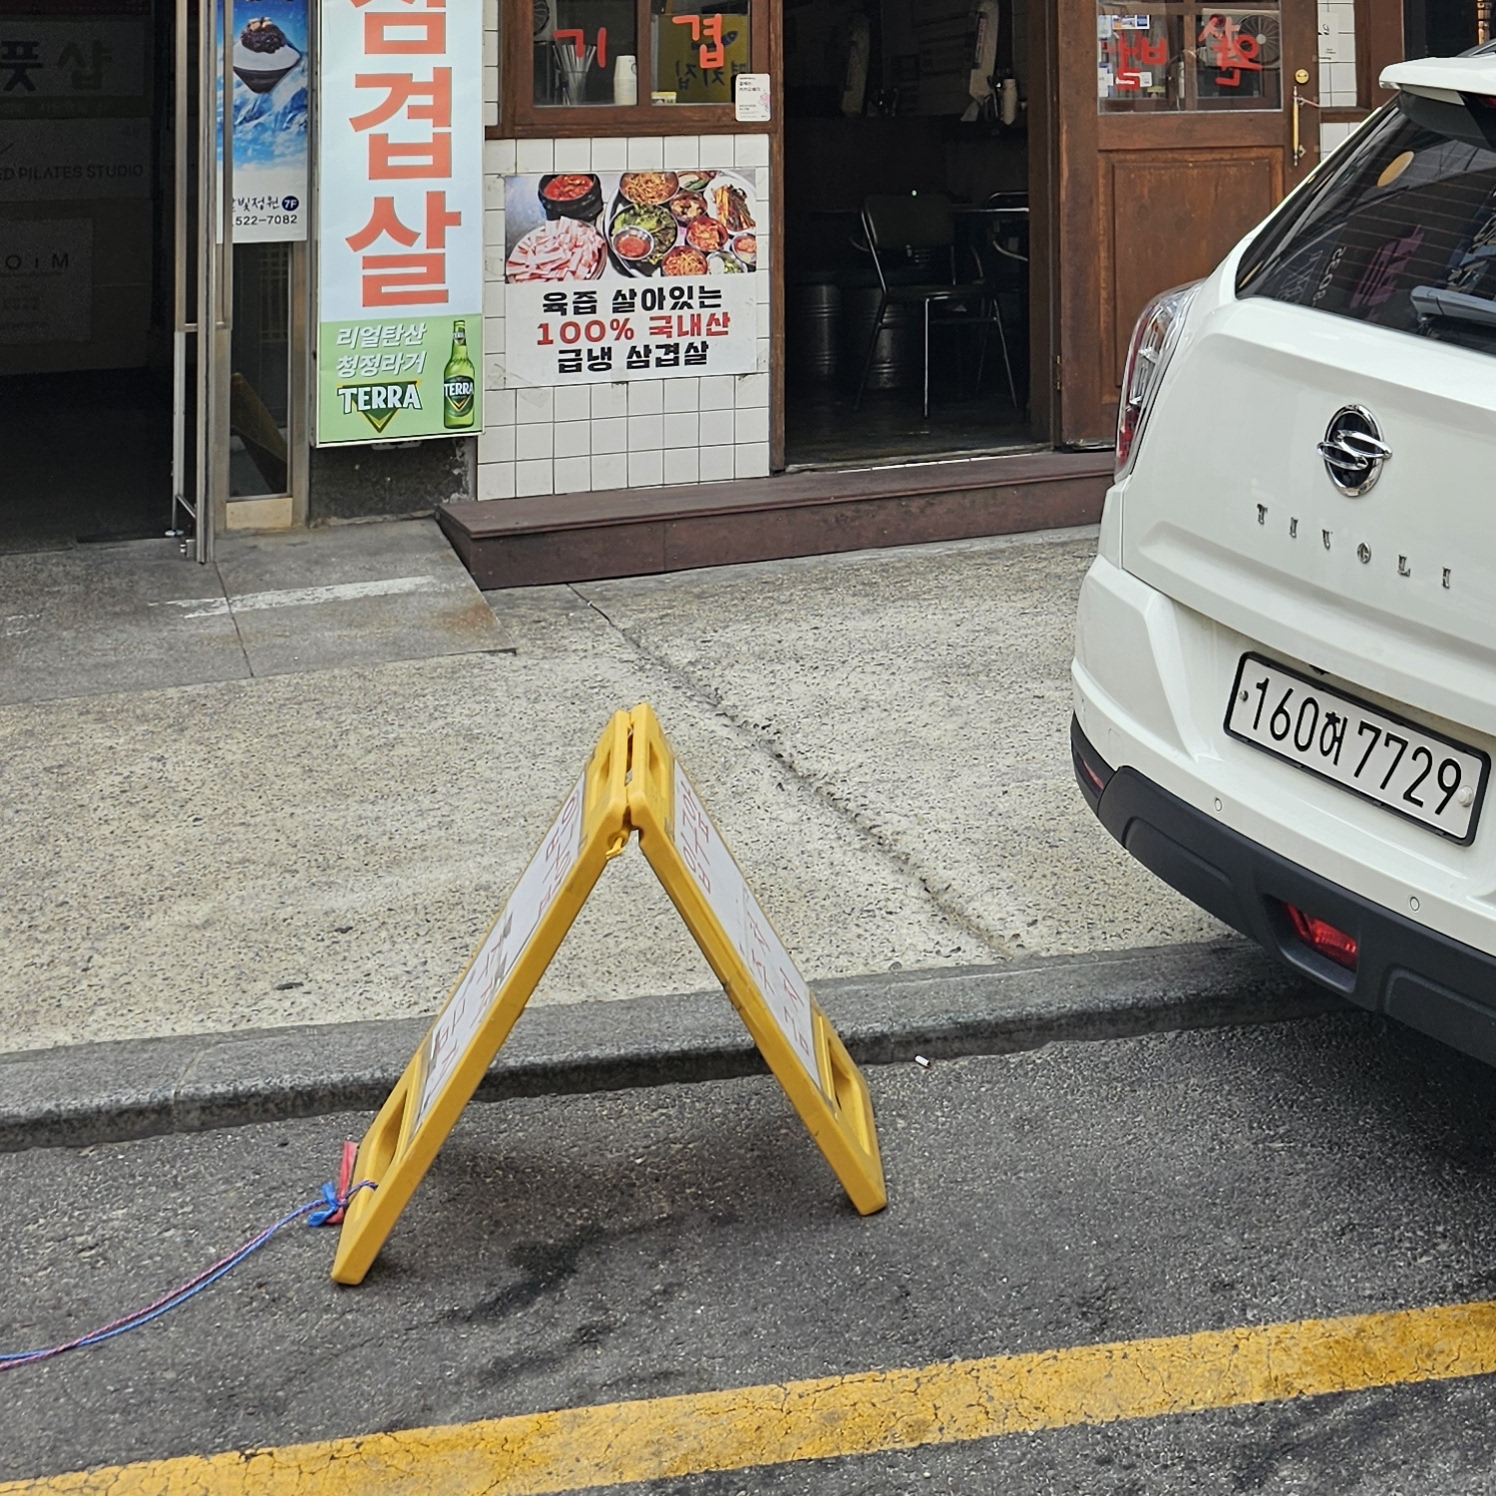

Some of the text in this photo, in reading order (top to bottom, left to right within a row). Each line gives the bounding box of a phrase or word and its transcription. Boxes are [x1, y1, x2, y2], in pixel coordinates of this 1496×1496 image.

[19, 165, 83, 181] PILATES
[86, 164, 144, 179] STUDIO
[541, 285, 723, 316] 육즙 살아있는
[336, 322, 427, 349] 리얼탄산
[537, 312, 731, 345] 100% 국내산
[336, 351, 427, 378] 청정라거
[557, 343, 709, 373] 급냉 삼겹살
[337, 384, 423, 415] TERRA
[444, 380, 474, 397] TERRA
[1256, 503, 1452, 589] TIVOLI
